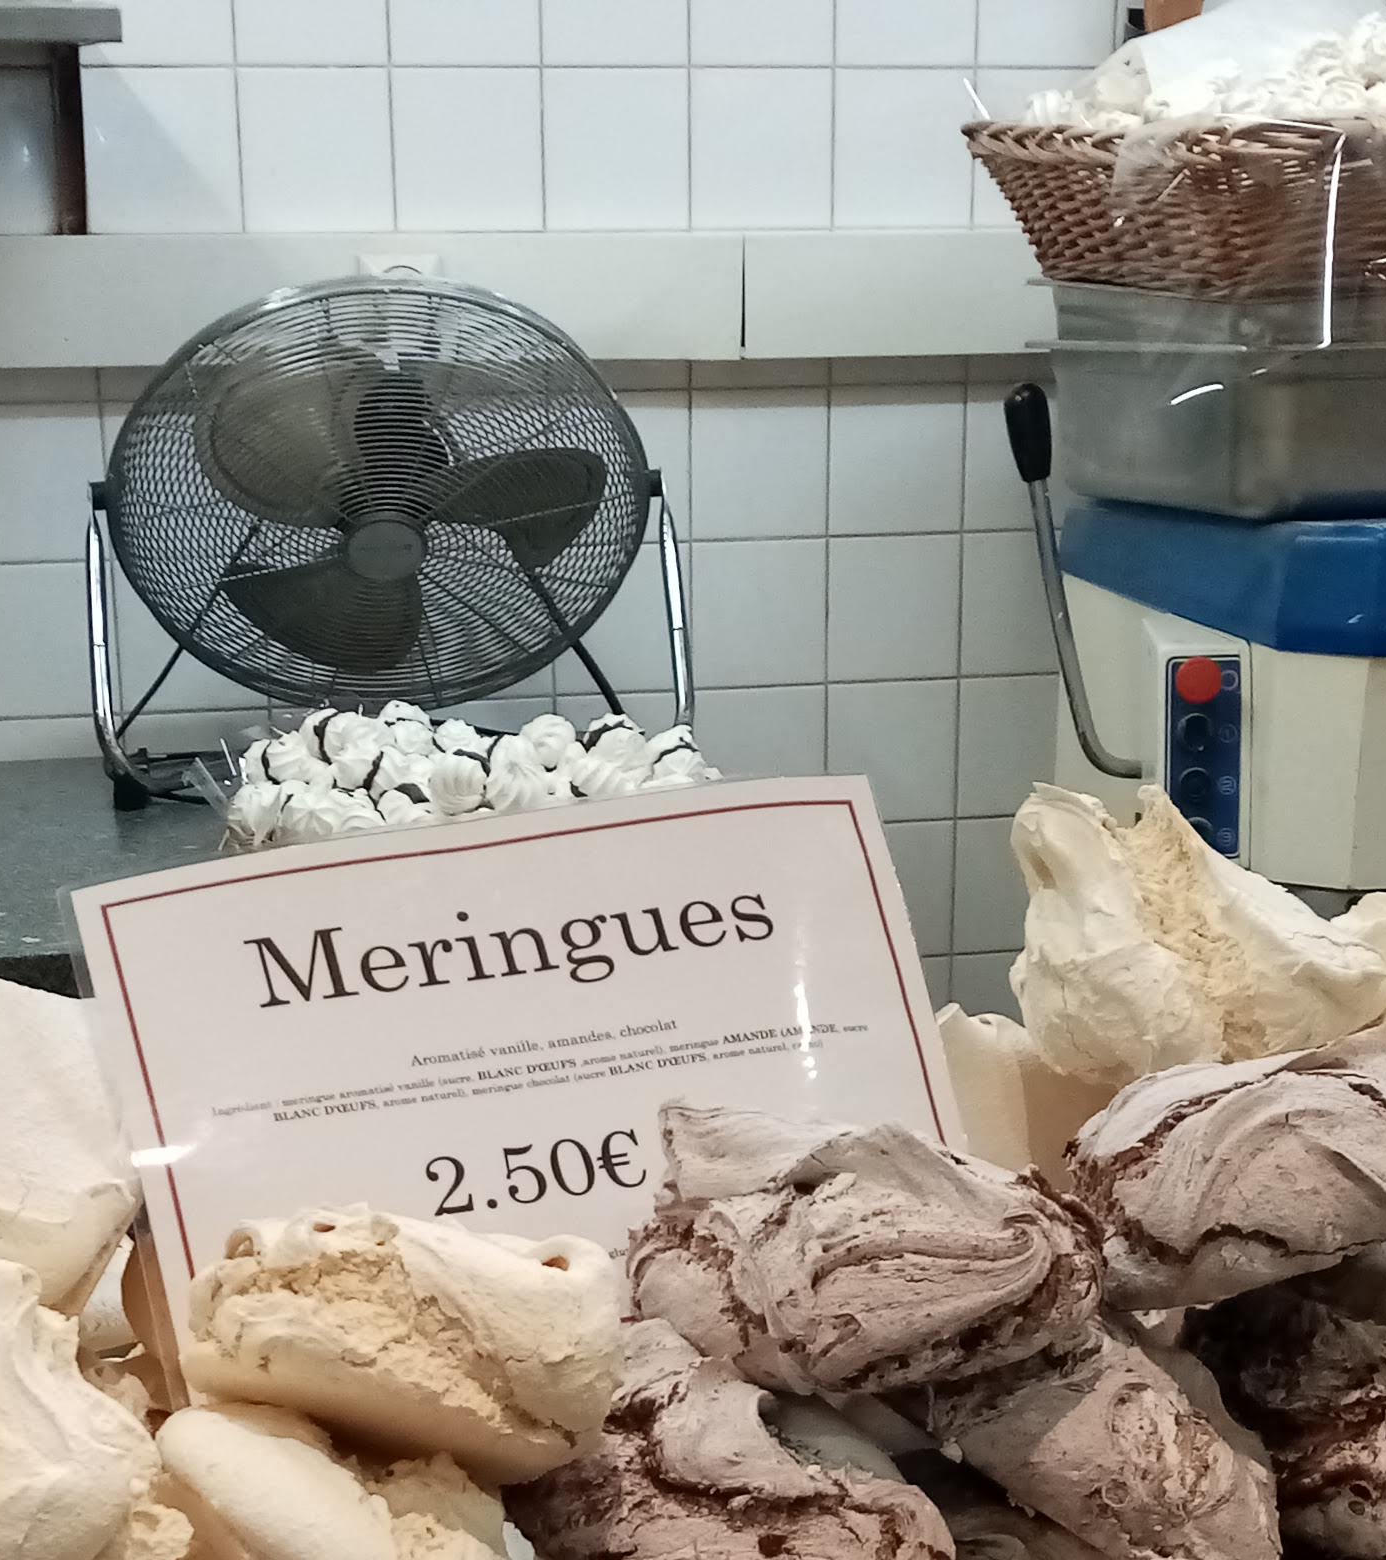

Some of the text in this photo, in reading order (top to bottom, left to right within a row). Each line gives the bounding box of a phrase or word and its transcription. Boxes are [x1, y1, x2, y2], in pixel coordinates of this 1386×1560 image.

[244, 892, 775, 1009] Meringues
[397, 1077, 436, 1092] vanille
[477, 1065, 525, 1082] BLANC
[526, 1058, 577, 1075] D'ŒUFS
[669, 1038, 720, 1055] meringue
[722, 1028, 778, 1046] AMANDE
[410, 1019, 678, 1068] Aromatisé vanille, amandes, chocolat
[273, 1107, 322, 1123] BLANC
[382, 1094, 418, 1108] arome
[471, 1080, 525, 1097] meringue
[526, 1074, 571, 1090] chocolat
[608, 1060, 654, 1077] BLANC
[425, 1128, 647, 1217] 2.50€
